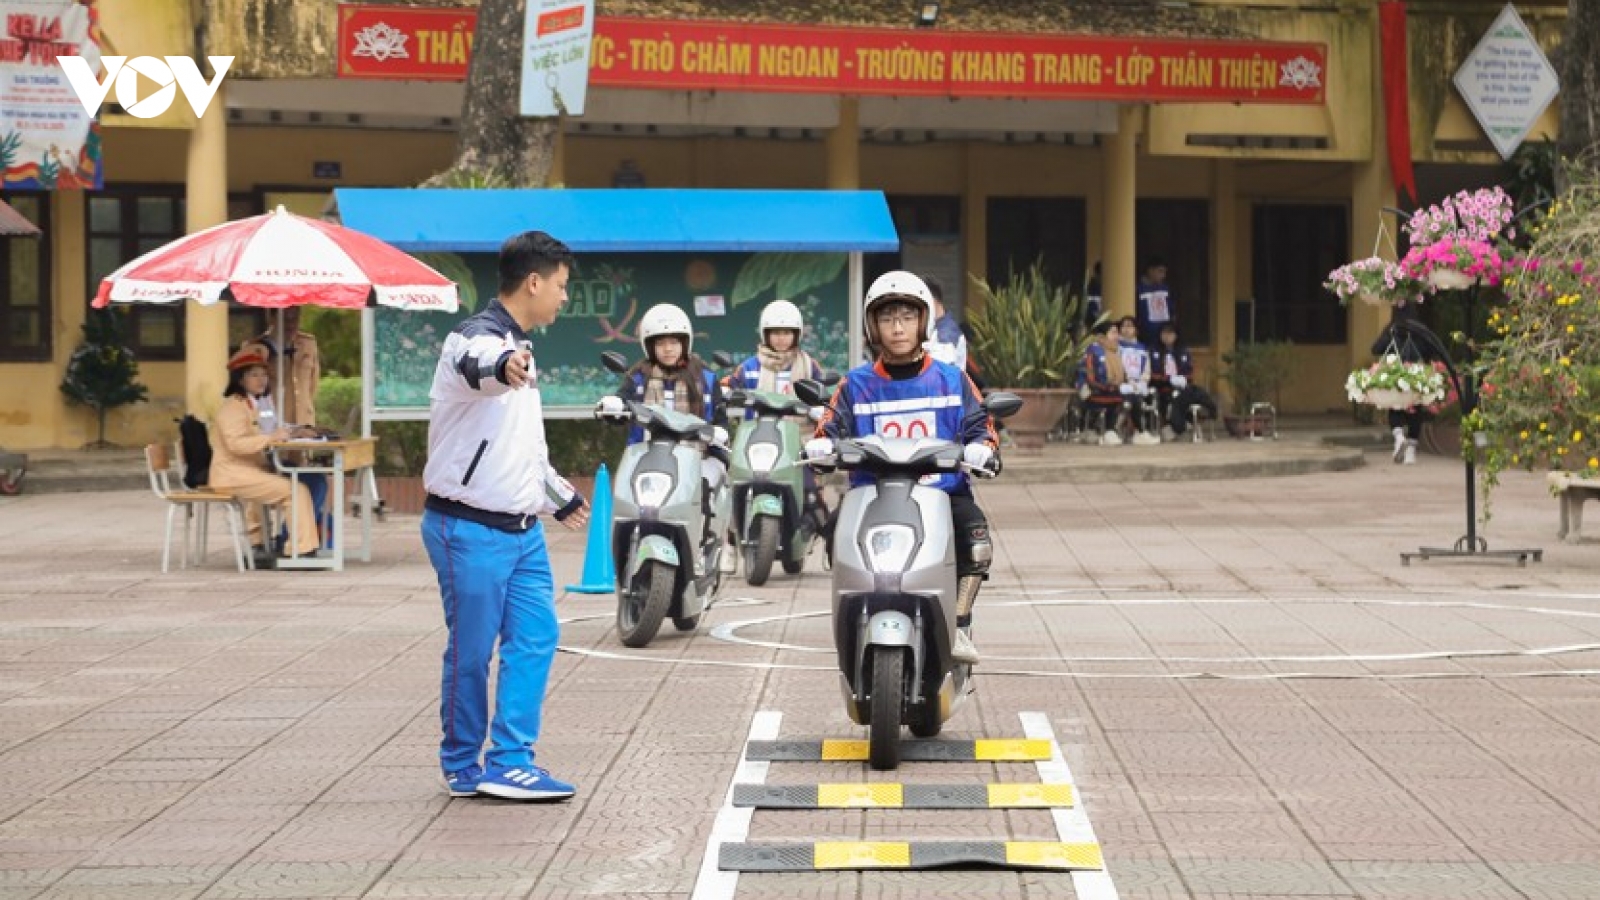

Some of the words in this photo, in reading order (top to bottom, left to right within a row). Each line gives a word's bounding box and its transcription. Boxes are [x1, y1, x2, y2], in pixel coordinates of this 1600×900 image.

[629, 31, 675, 72] TRÒ
[681, 36, 752, 76] CHĂM
[758, 44, 840, 78] NGOAN
[856, 42, 946, 82] TRƯỜNG
[950, 51, 1025, 83] KHANG
[1032, 53, 1102, 84] TRANG
[1115, 46, 1154, 86] LỚP
[1160, 51, 1213, 87] THÂN
[1219, 53, 1277, 97] THIỆN
